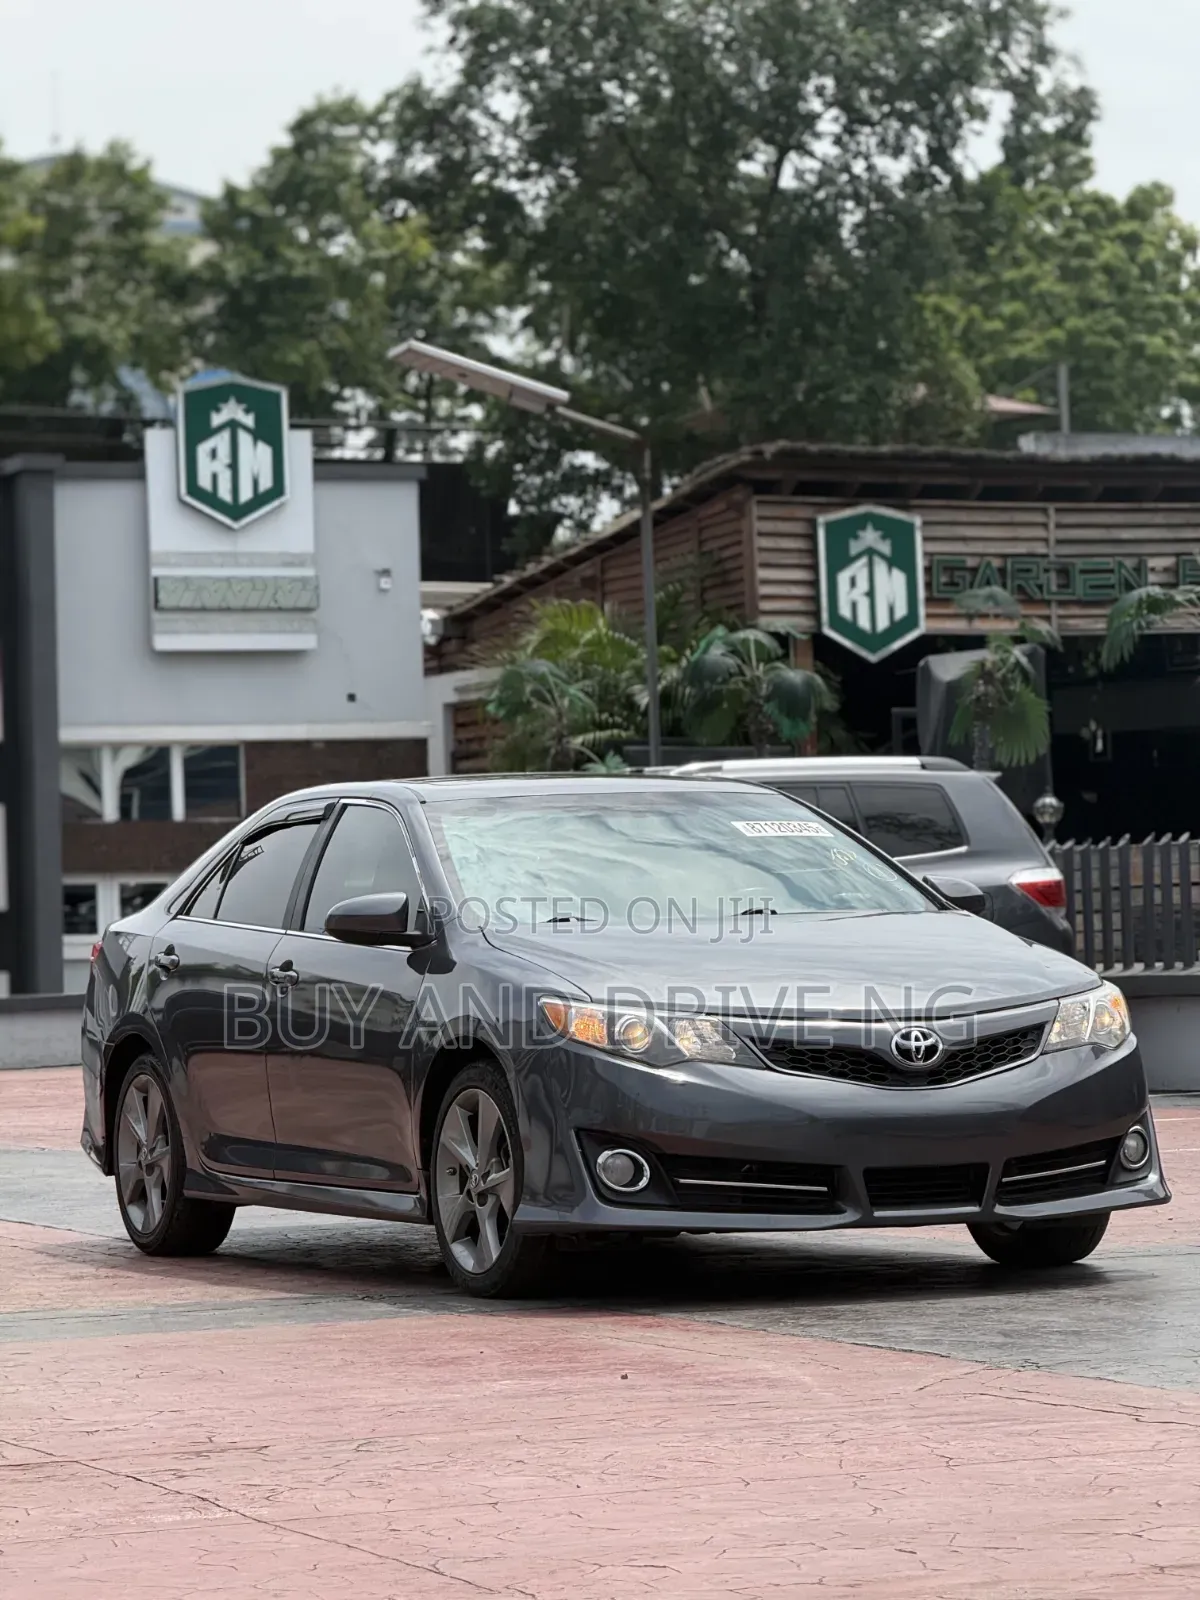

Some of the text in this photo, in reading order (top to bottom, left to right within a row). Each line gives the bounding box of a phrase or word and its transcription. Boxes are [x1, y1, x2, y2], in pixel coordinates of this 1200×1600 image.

[196, 427, 274, 506] RM
[836, 553, 909, 634] RM
[931, 554, 1149, 599] GARDEN
